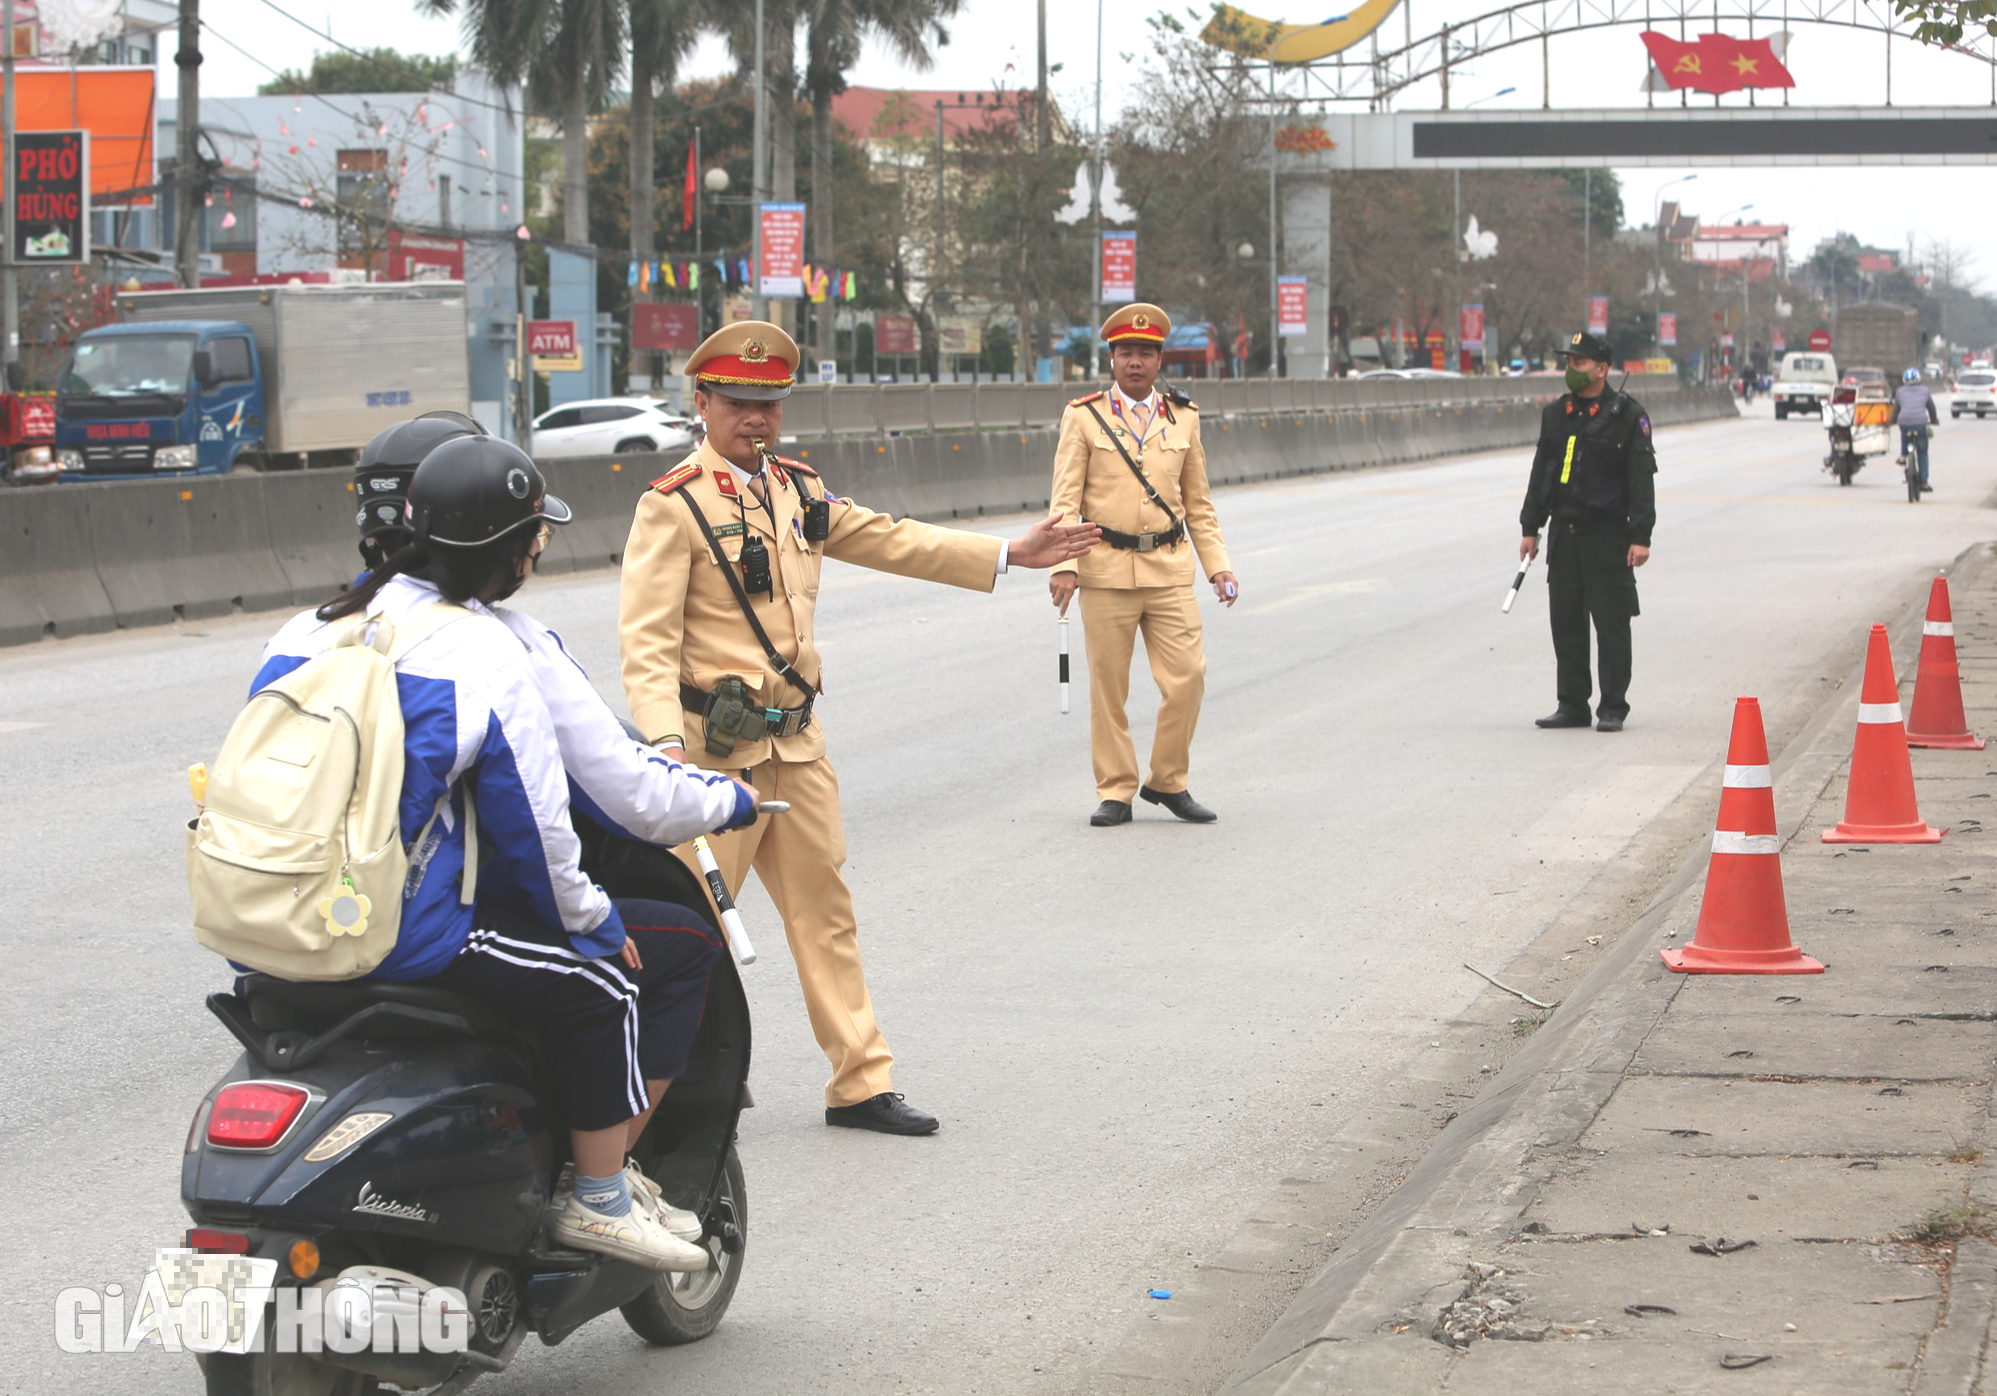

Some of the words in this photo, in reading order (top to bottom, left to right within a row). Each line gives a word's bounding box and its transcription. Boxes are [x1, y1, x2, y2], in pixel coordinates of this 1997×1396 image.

[18, 135, 79, 180] PHỞ
[18, 184, 78, 220] HÙNG
[531, 334, 571, 350] ATM
[352, 1180, 426, 1221] Victoria
